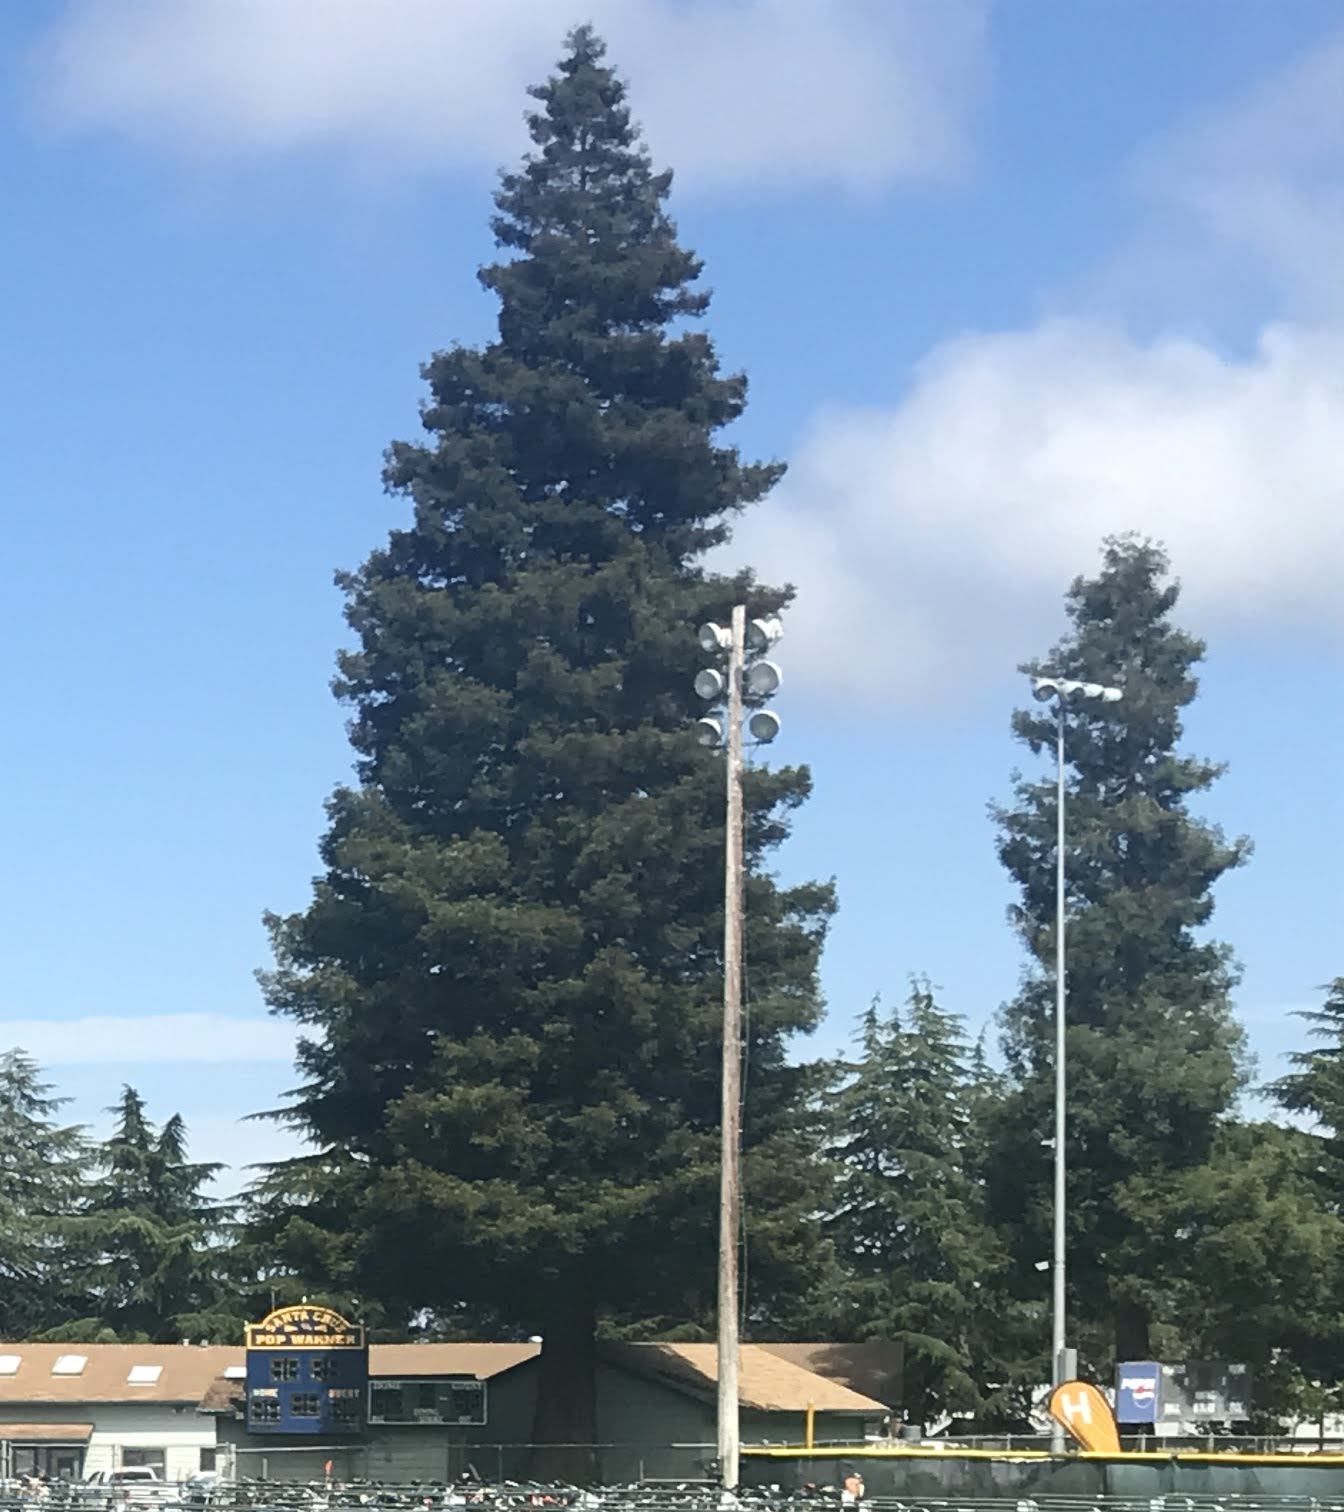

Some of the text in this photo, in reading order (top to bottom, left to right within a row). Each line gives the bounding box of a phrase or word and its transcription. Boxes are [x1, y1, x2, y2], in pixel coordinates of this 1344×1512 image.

[265, 1310, 309, 1332] SANTA
[255, 1334, 355, 1345] POP WARNER
[1060, 1391, 1092, 1424] H
